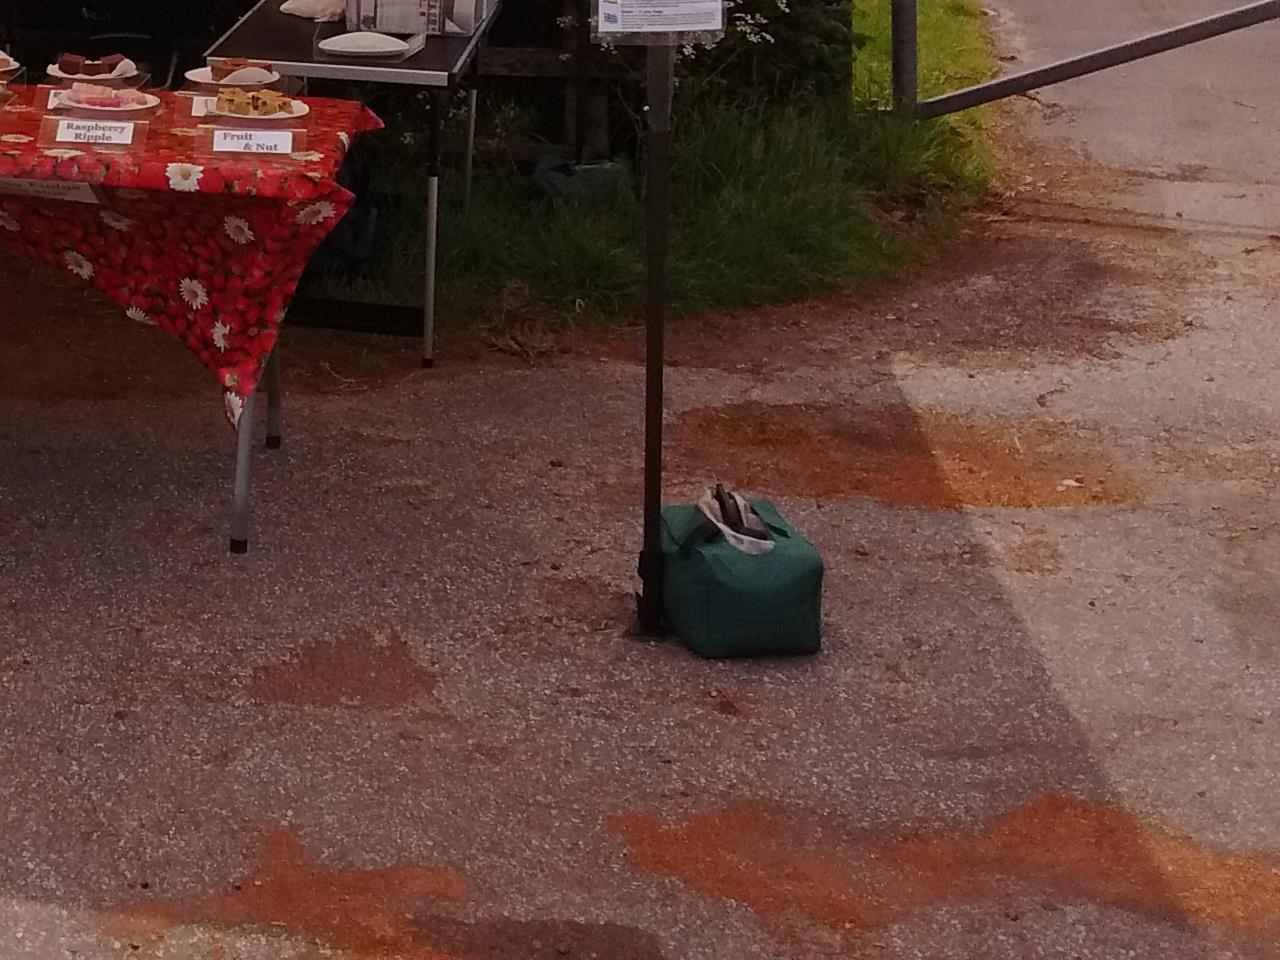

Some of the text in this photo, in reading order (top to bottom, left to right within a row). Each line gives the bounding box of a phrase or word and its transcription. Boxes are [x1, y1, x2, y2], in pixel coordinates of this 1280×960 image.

[66, 122, 127, 134] Raspberry
[74, 132, 112, 142] Ripple
[223, 132, 254, 140] Fruit
[243, 143, 279, 151] & Nut
